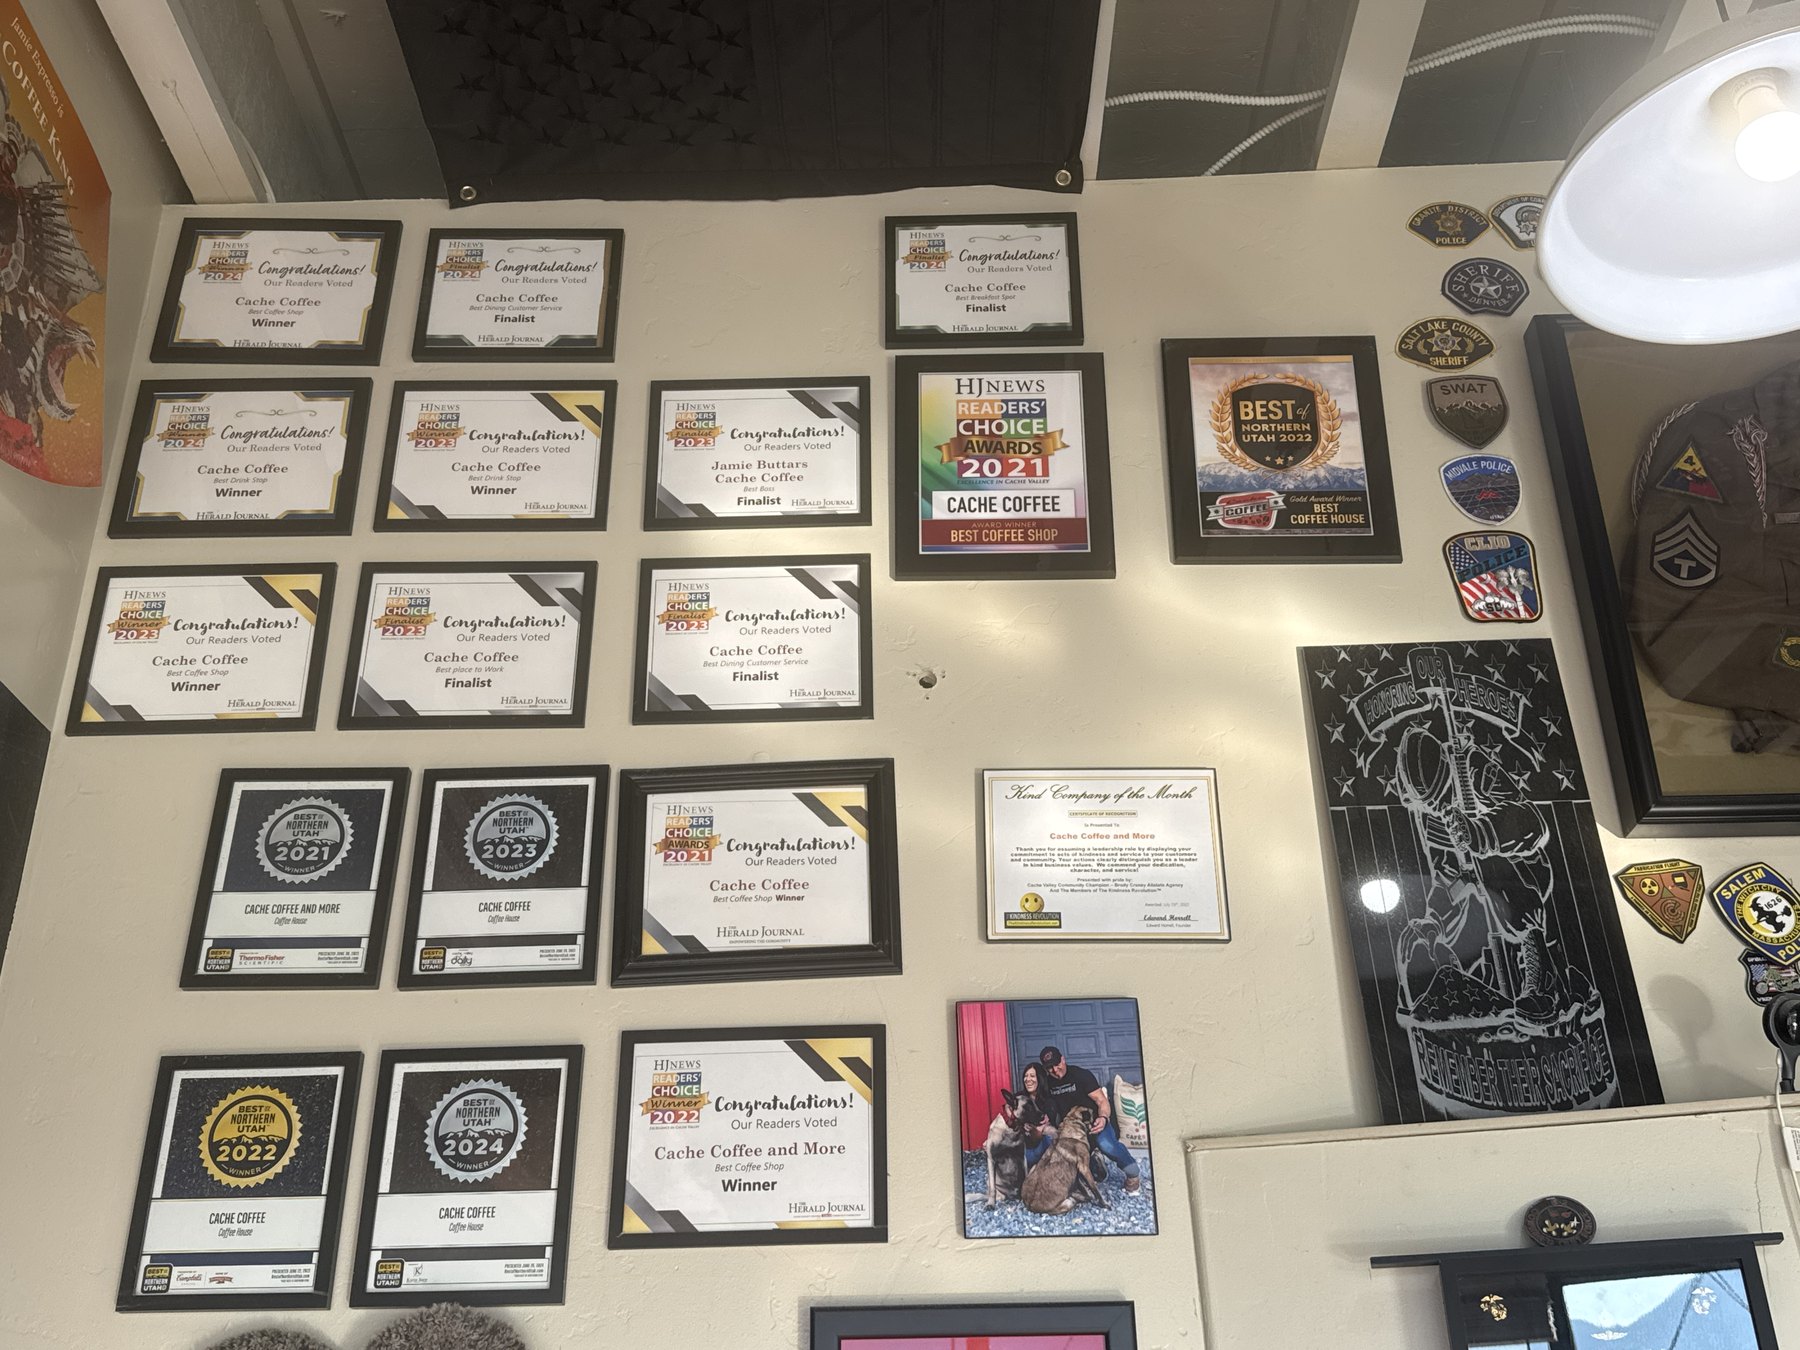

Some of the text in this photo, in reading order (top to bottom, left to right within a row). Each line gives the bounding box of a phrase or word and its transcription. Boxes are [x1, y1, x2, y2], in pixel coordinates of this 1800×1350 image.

[11, 17, 64, 118] Jamie Expresso is
[2, 41, 75, 196] COFFEE KING
[1413, 206, 1441, 226] GRANITE
[1448, 206, 1486, 226] DISTRICT
[959, 249, 1060, 265] Congratulations!
[258, 261, 365, 279] Congratulations!
[1452, 265, 1519, 293] SHERIFF
[945, 283, 1026, 292] Cache Coffee
[966, 304, 1006, 312] Finalist
[252, 318, 296, 327] Winner
[494, 315, 535, 323] Finalist
[1402, 321, 1489, 350] SALT LAKE COUNTY
[1430, 357, 1469, 365] SHERIFF
[956, 378, 1045, 397] HJNEWS
[1440, 383, 1487, 395] SWAT
[1239, 400, 1310, 420] BEST of
[959, 419, 1044, 435] CHOICE
[469, 429, 585, 444] Congratulations!
[731, 426, 845, 443] Congratulations!
[1242, 434, 1275, 442] UTAH
[964, 440, 1042, 455] AWARDS
[451, 462, 541, 472] Cache Coffee
[711, 460, 808, 470] Jamie Buttars
[962, 458, 1043, 477] 2021
[1684, 456, 1696, 467] 4
[1445, 461, 1512, 480] MIDVALE POLICE
[715, 473, 803, 483] Cache Coffee
[215, 488, 262, 497] Winner
[471, 486, 517, 494] Winner
[737, 496, 781, 506] Finalist
[947, 496, 1060, 513] CACHE COFFEE
[1226, 504, 1269, 515] COFFEE
[1314, 504, 1339, 512] BEST
[1290, 514, 1365, 524] COFFEE HOUSE
[951, 529, 1058, 542] BEST COFFEE SHOP
[1464, 536, 1510, 550] CLIO
[1457, 545, 1529, 582] POLICE
[1674, 558, 1697, 578] T
[174, 617, 299, 636] Congratulations!
[443, 616, 566, 632] Congratulations!
[733, 671, 779, 681] Finalist
[171, 682, 220, 692] Winner
[444, 678, 492, 688] Finalist
[1364, 655, 1518, 724] HONORING OUR HEROES
[1005, 784, 1198, 803] Kind Company of the Month
[286, 821, 329, 830] NORTHERN
[666, 828, 712, 837] CHOICE
[668, 840, 709, 849] AWARDS
[727, 837, 855, 857] Congratulations!
[275, 847, 330, 861] 2021
[482, 844, 537, 858] 2023
[667, 851, 710, 862] 2021
[284, 866, 315, 874] WINNER
[494, 863, 524, 871] WINNER
[710, 879, 809, 891] Cache Coffee
[1721, 869, 1766, 899] SALEM
[713, 894, 805, 904] Best Coffee Shop Winner
[1738, 885, 1760, 901] WITCH
[1761, 885, 1781, 893] CITY
[479, 901, 531, 912] CACHE COFFEE
[1764, 896, 1782, 910] 1626
[245, 904, 340, 915] CACHE COFFEE AND MORE
[717, 926, 805, 937] HERALD JOURNAL
[1413, 1027, 1611, 1107] REMEMBER THEIR SACRIFICE
[651, 1098, 701, 1108] Winner
[715, 1092, 854, 1117] Congratulations!
[456, 1107, 500, 1118] NORTHERN
[231, 1113, 276, 1125] NORTHERN
[463, 1118, 491, 1126] UTAH
[731, 1117, 837, 1130] Our Readers Voted
[238, 1125, 266, 1133] UTAH
[216, 1144, 277, 1161] 2022
[443, 1139, 503, 1156] 2024
[655, 1142, 846, 1160] Cache Coffee and More
[456, 1160, 489, 1170] WINNER
[715, 1162, 784, 1173] Best Coffee Shop
[229, 1167, 262, 1176] WINNER
[721, 1179, 777, 1192] Winner
[209, 1212, 266, 1224] CACHE COFFEE
[439, 1206, 496, 1219] CACHE COFFEE
[449, 1222, 483, 1233] Coffee House
